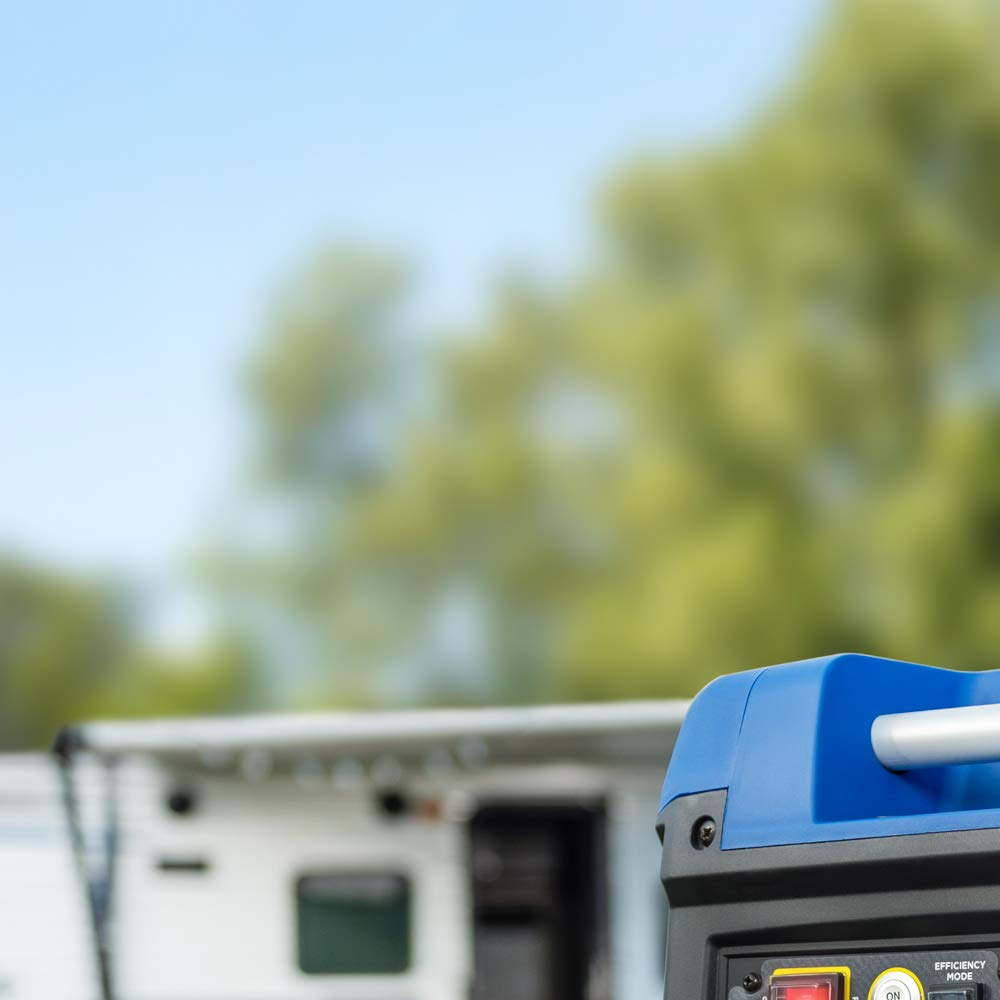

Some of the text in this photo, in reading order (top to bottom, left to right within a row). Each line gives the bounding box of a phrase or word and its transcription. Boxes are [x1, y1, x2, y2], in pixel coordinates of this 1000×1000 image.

[934, 960, 986, 970] EFFICIENCY
[946, 972, 973, 981] MODE
[886, 991, 900, 1000] ON
